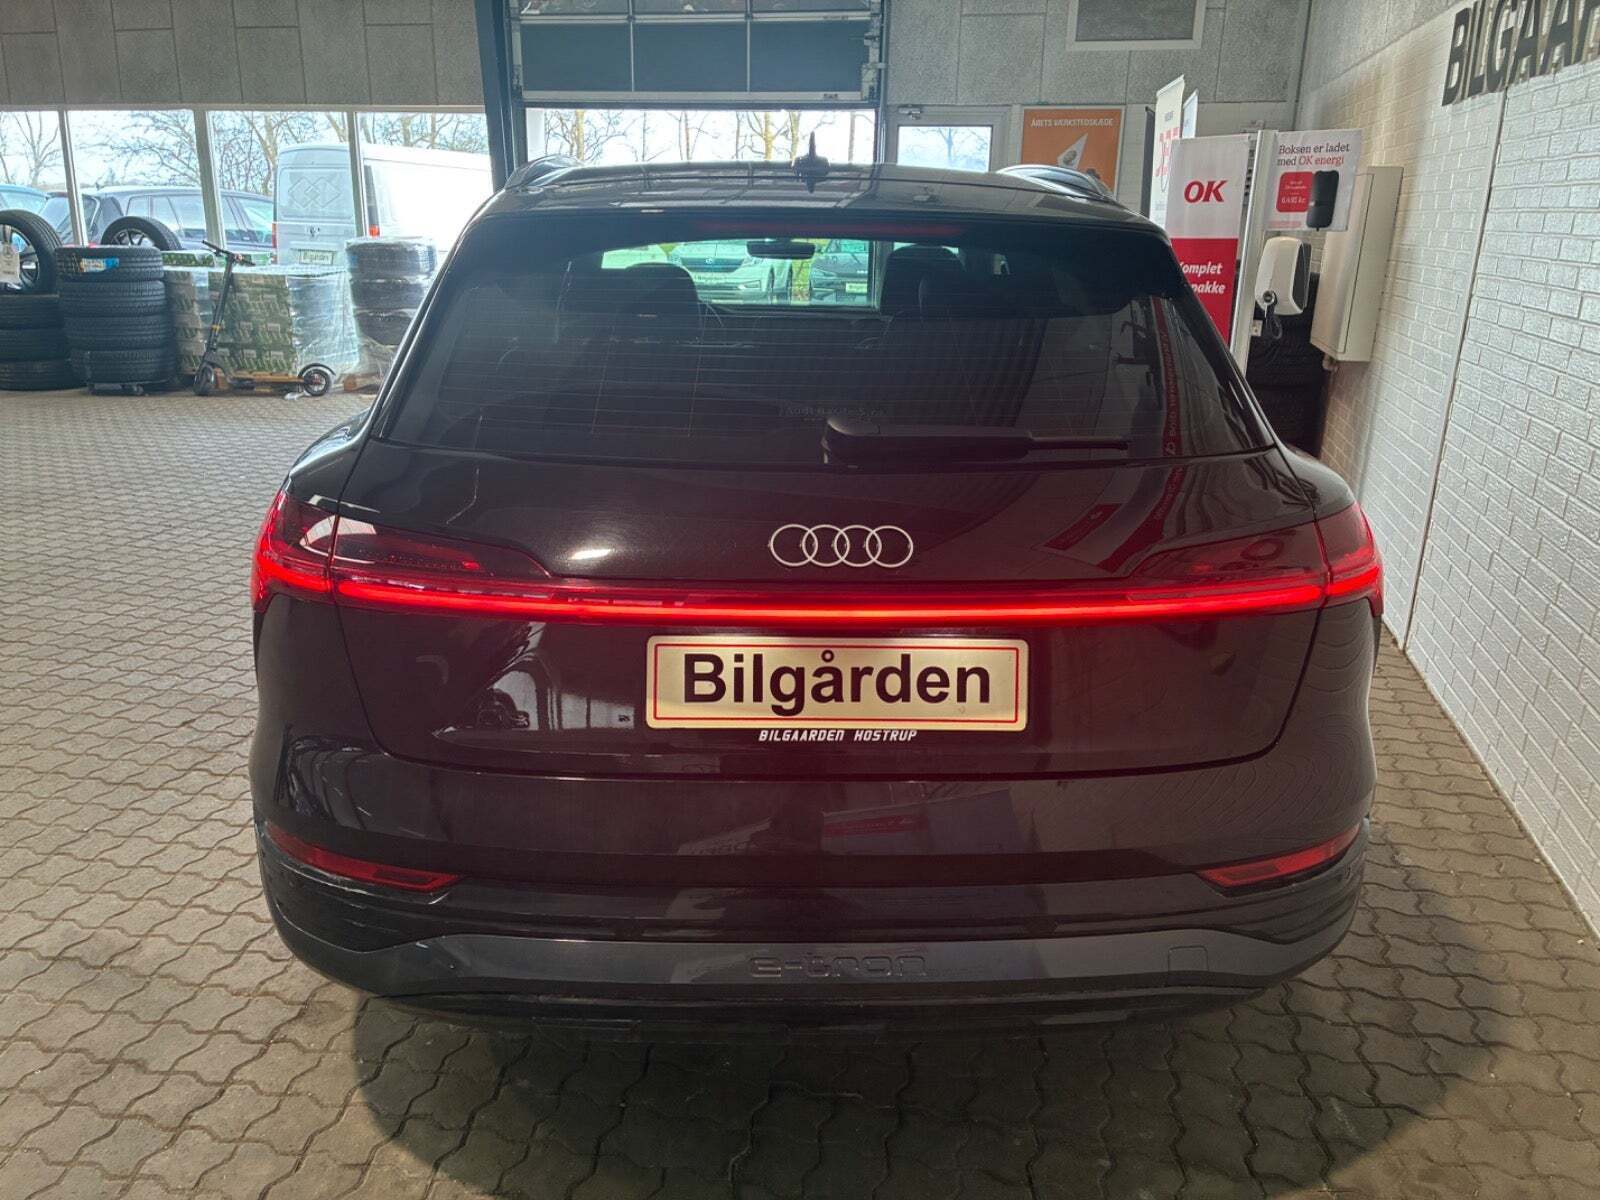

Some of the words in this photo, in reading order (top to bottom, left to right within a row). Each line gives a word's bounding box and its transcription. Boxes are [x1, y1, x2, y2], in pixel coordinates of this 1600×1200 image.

[1279, 144, 1312, 155] Boksen
[1313, 145, 1323, 153] er
[1325, 141, 1350, 153] ladet
[1277, 155, 1297, 166] med
[1298, 155, 1313, 165] OK
[1315, 155, 1344, 167] energi
[1184, 180, 1228, 203] OK
[684, 650, 990, 716] Bilgården
[758, 729, 845, 742] BILGAARDEN
[853, 729, 918, 742] HOSTRUP
[750, 952, 926, 978] e-tron
